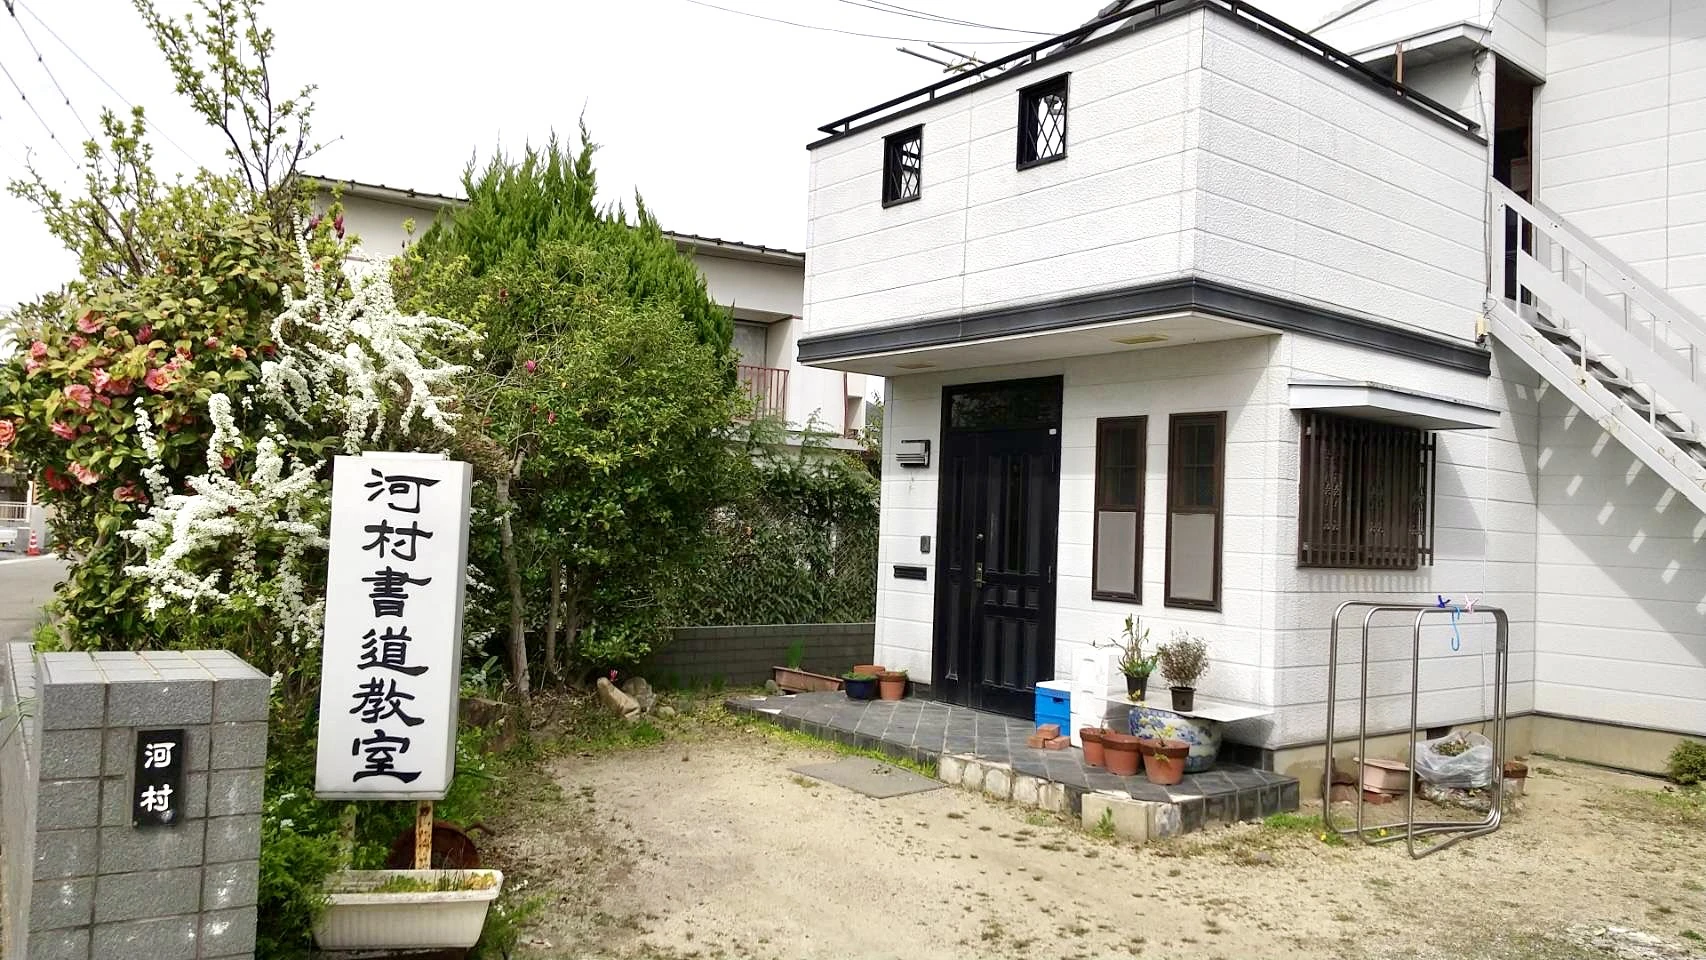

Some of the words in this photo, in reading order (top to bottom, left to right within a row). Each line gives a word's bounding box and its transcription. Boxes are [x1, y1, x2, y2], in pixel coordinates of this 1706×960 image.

[350, 468, 441, 783] 河村書道教室
[140, 742, 176, 812] 河村
